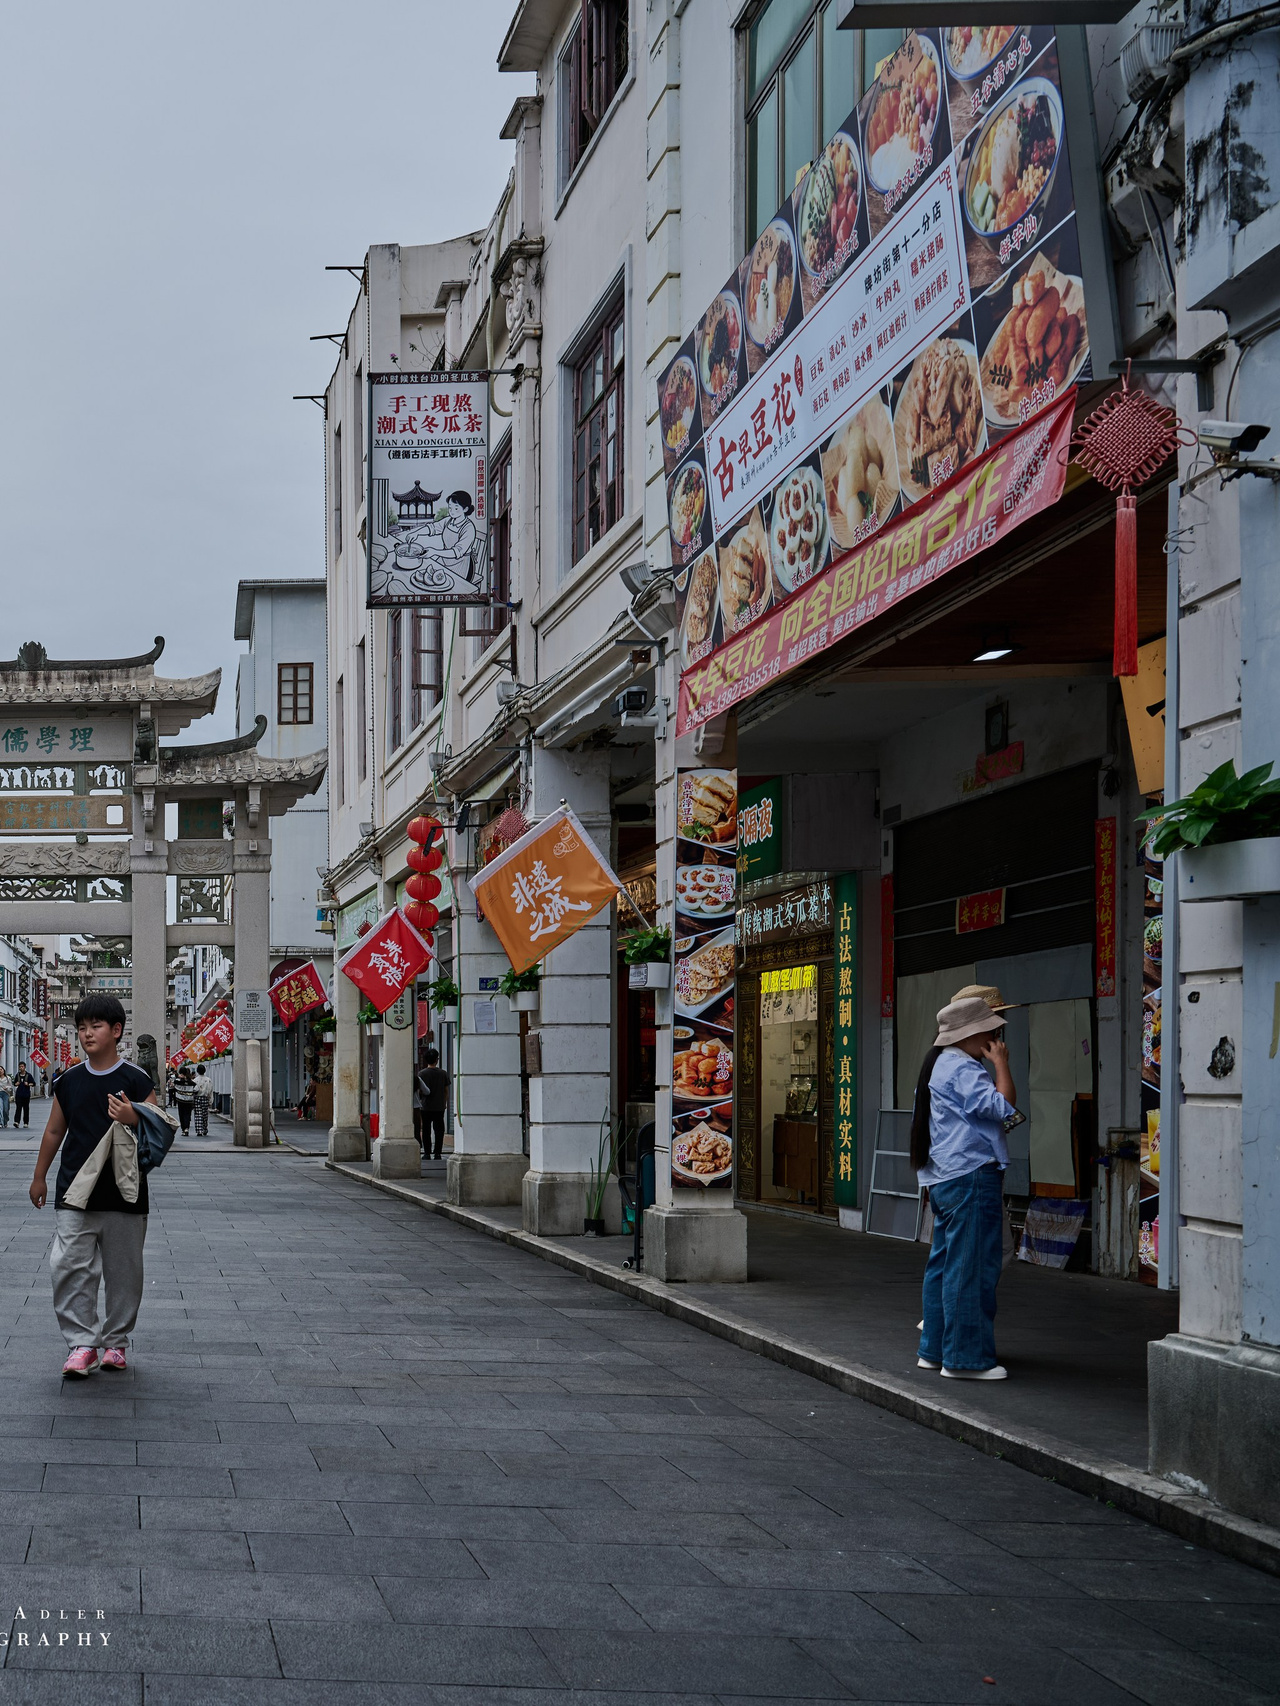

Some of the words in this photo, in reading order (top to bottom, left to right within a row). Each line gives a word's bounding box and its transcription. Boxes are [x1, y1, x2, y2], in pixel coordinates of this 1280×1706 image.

[971, 34, 1032, 117] 五谷清心丸
[864, 201, 942, 295] 牌坊街第十一分店
[999, 214, 1038, 264] 鲜芋仙
[810, 356, 824, 383] 豆花
[851, 313, 868, 339] 沙冰
[875, 279, 901, 313] 牛肉丸
[910, 231, 944, 279] 糯米猪肠
[380, 373, 480, 383] 小时候灶台边的冬瓜茶
[1019, 377, 1056, 420] 炸牛奶
[377, 414, 483, 434] 潮式冬瓜茶
[388, 393, 472, 414] 手工现熬
[388, 448, 472, 460] (遵循古法手工制作)
[417, 438, 463, 446] DONGGUA
[466, 437, 485, 445] TEA
[712, 372, 796, 502] 古早豆花
[688, 621, 770, 711] 古早豆花
[778, 454, 1008, 653] 向全国招商合作
[788, 627, 828, 664] 诚招联营
[832, 593, 878, 636] 整店输出
[884, 515, 997, 603] 零基础也能开好店
[743, 896, 819, 935] 传统潮式冬瓜茶
[717, 1052, 729, 1080] 炸牛奶
